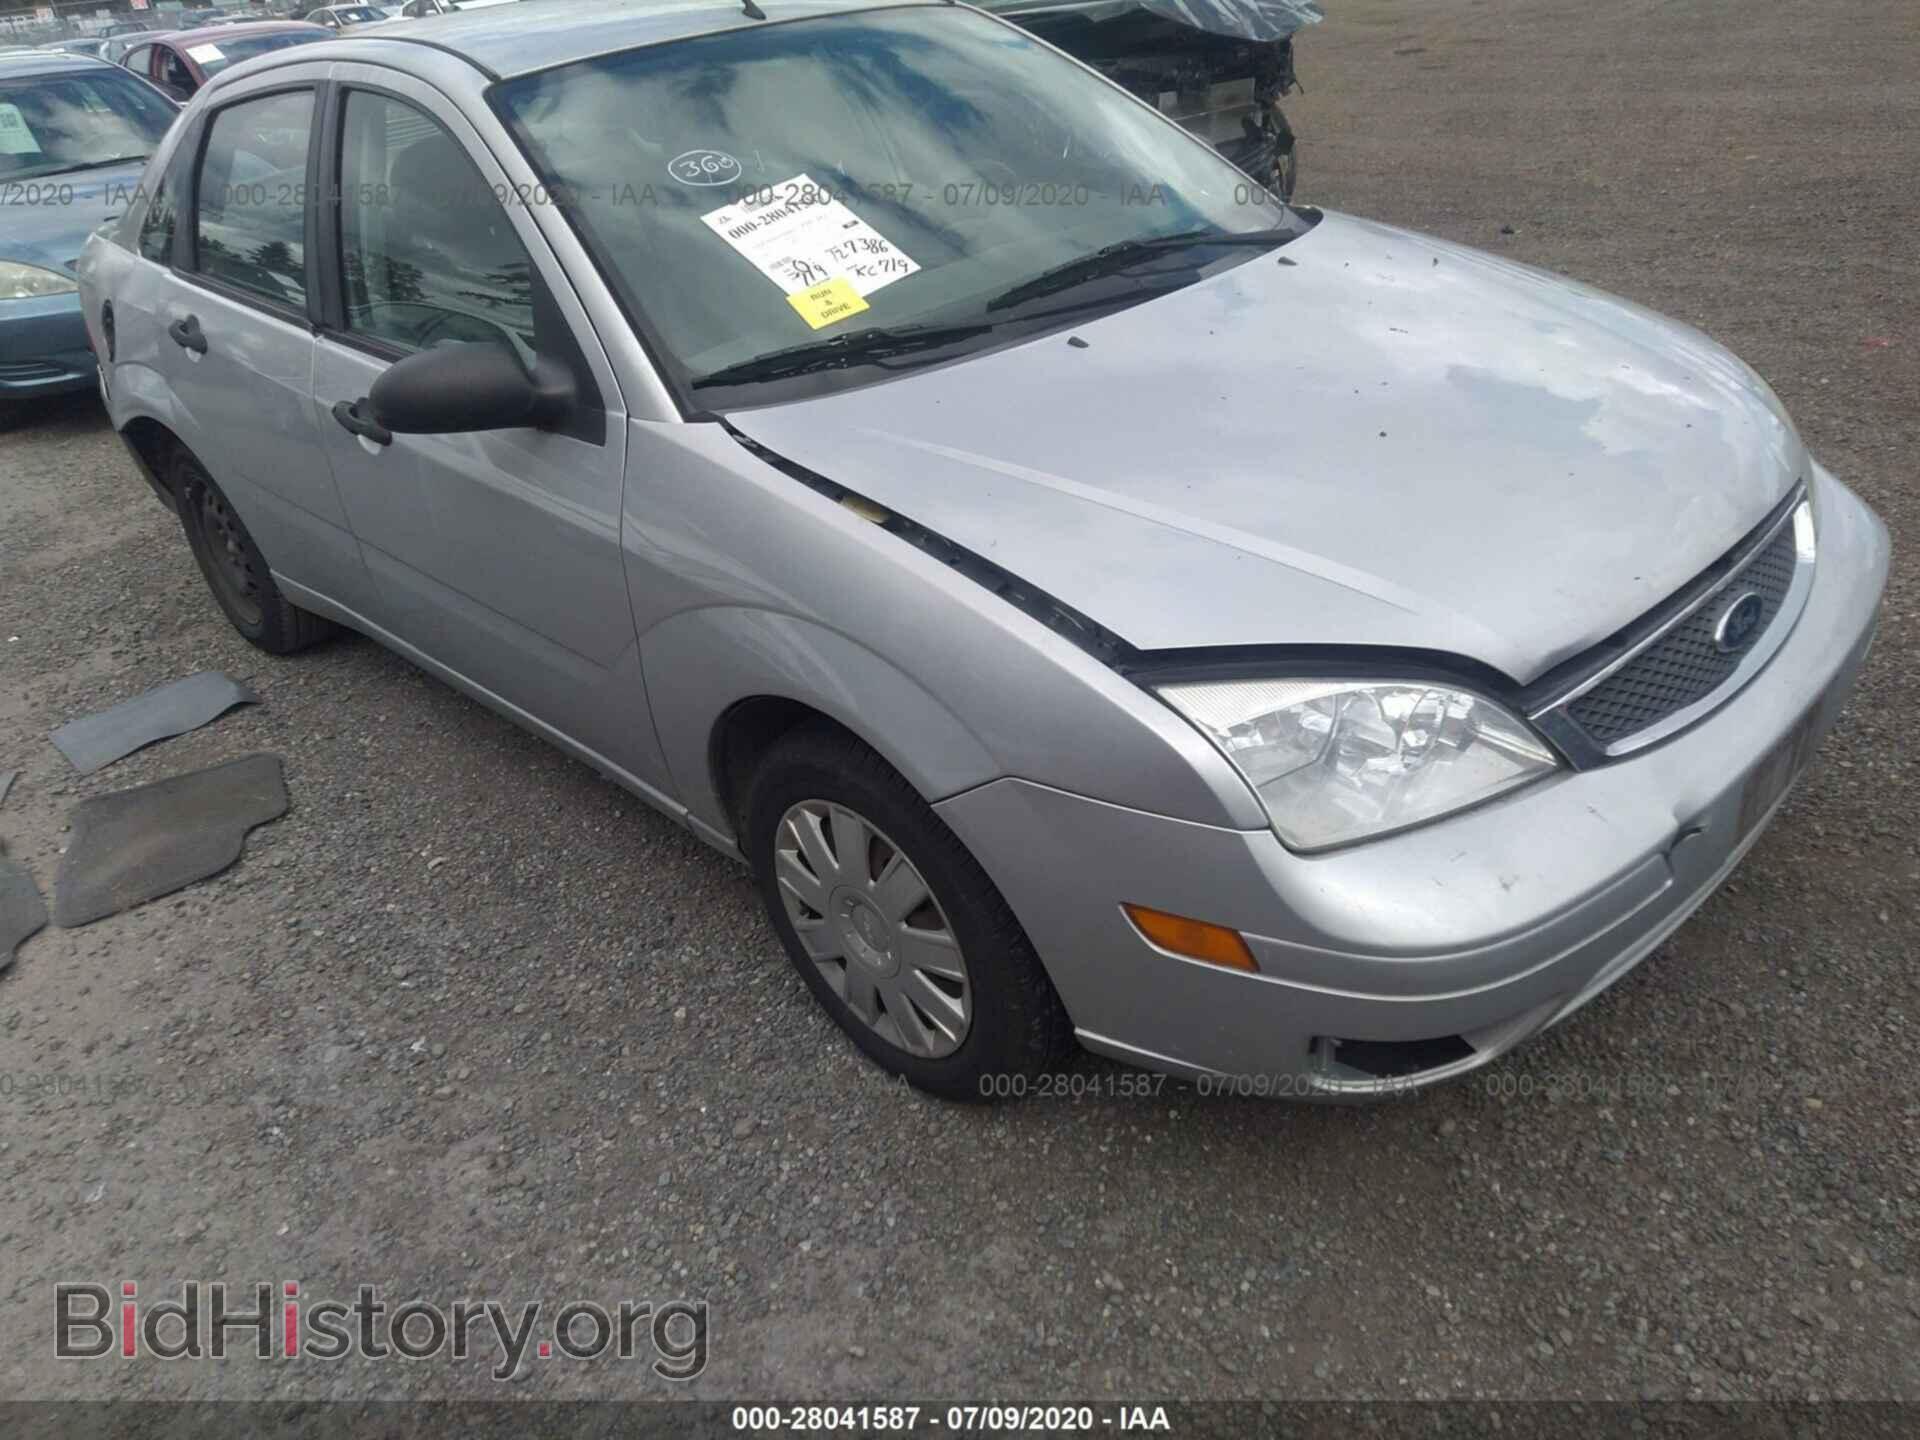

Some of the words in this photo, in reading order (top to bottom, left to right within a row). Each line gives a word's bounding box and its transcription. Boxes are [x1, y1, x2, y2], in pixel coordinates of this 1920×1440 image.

[728, 193, 818, 239] 000-28041
[811, 288, 832, 301] RUN
[820, 303, 851, 318] DRIVE
